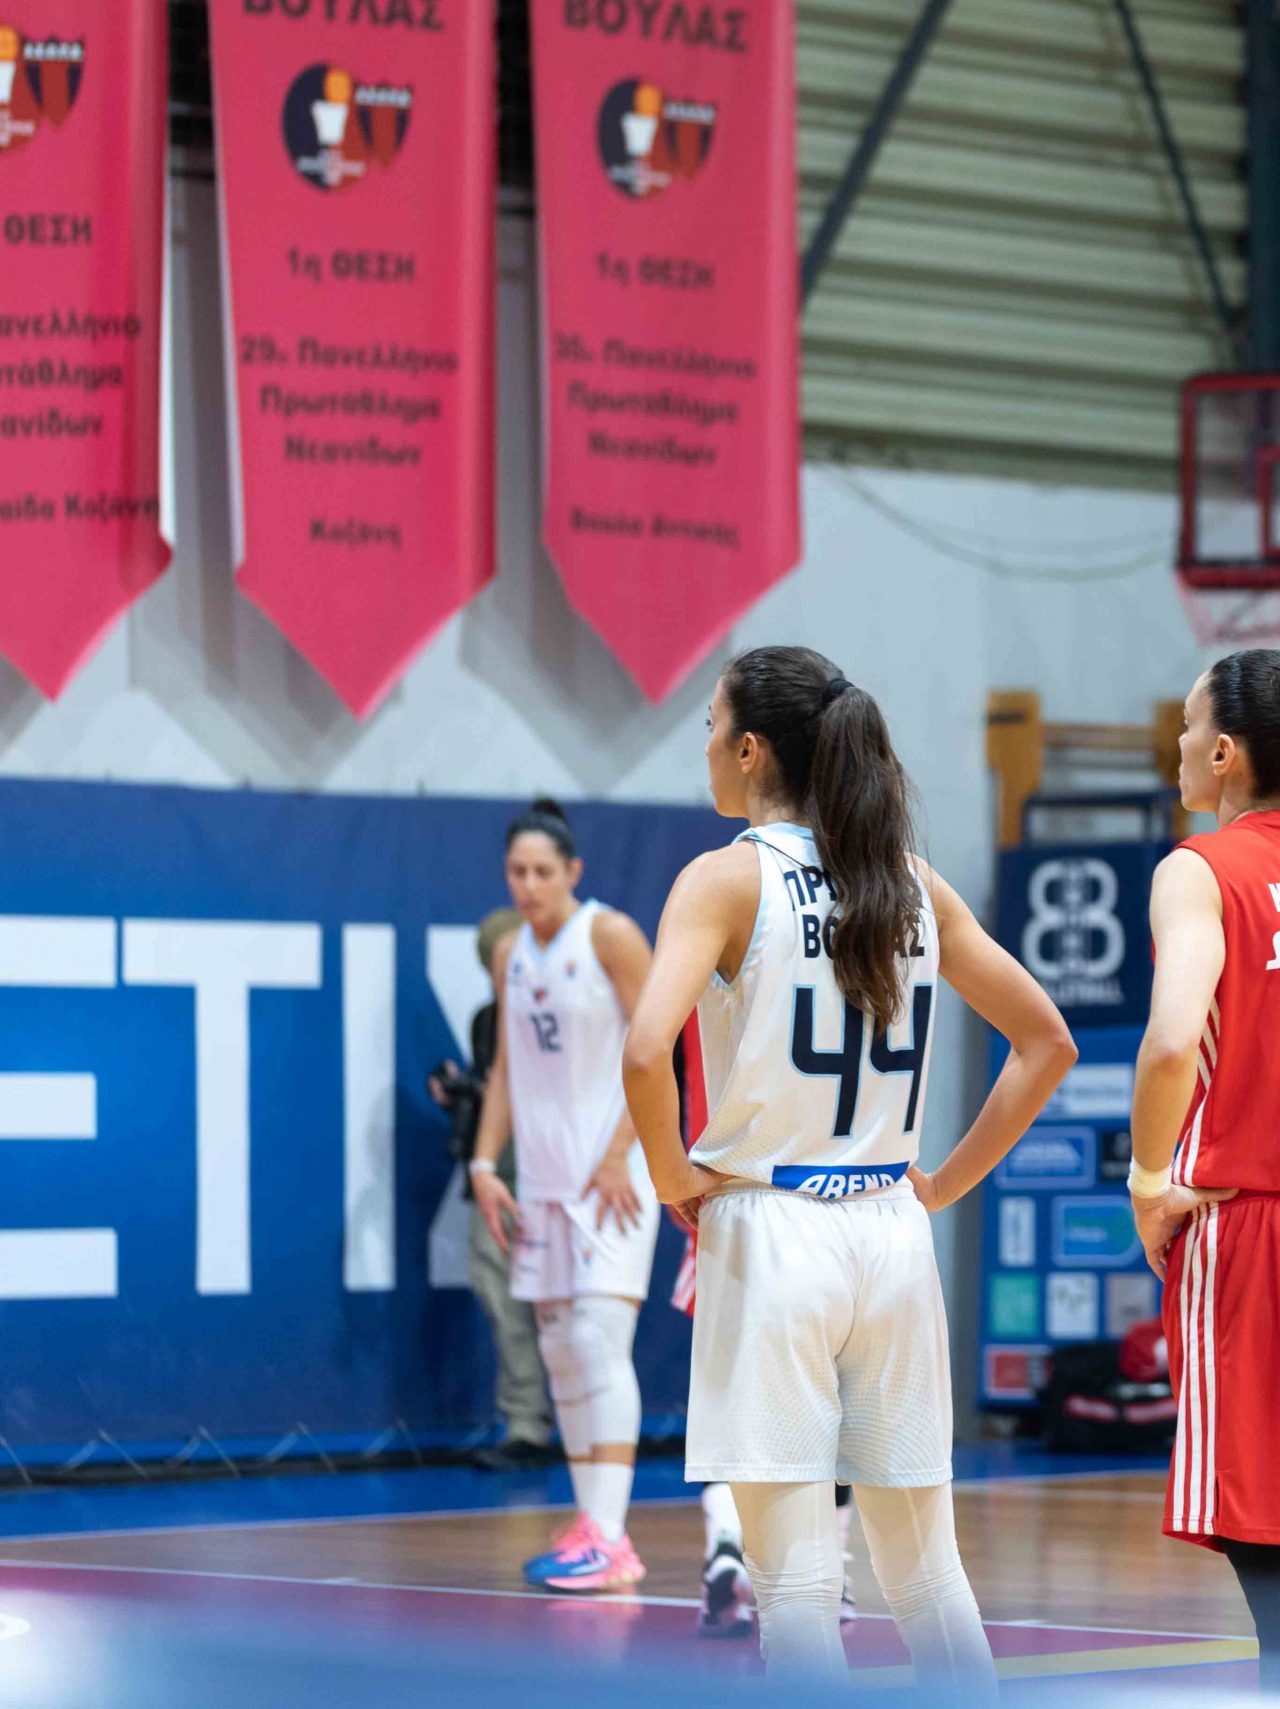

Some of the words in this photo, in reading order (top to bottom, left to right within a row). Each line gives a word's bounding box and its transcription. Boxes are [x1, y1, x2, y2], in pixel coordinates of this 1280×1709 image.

[4, 215, 92, 245] ΘΕΣΗ
[331, 251, 416, 283] ΘΕΣΗ
[0, 310, 142, 342] ανελλήνιο
[0, 360, 124, 392] τάθλημα
[0, 410, 104, 438] ανίδων
[531, 1012, 563, 1054] 12
[790, 984, 933, 1139] 44
